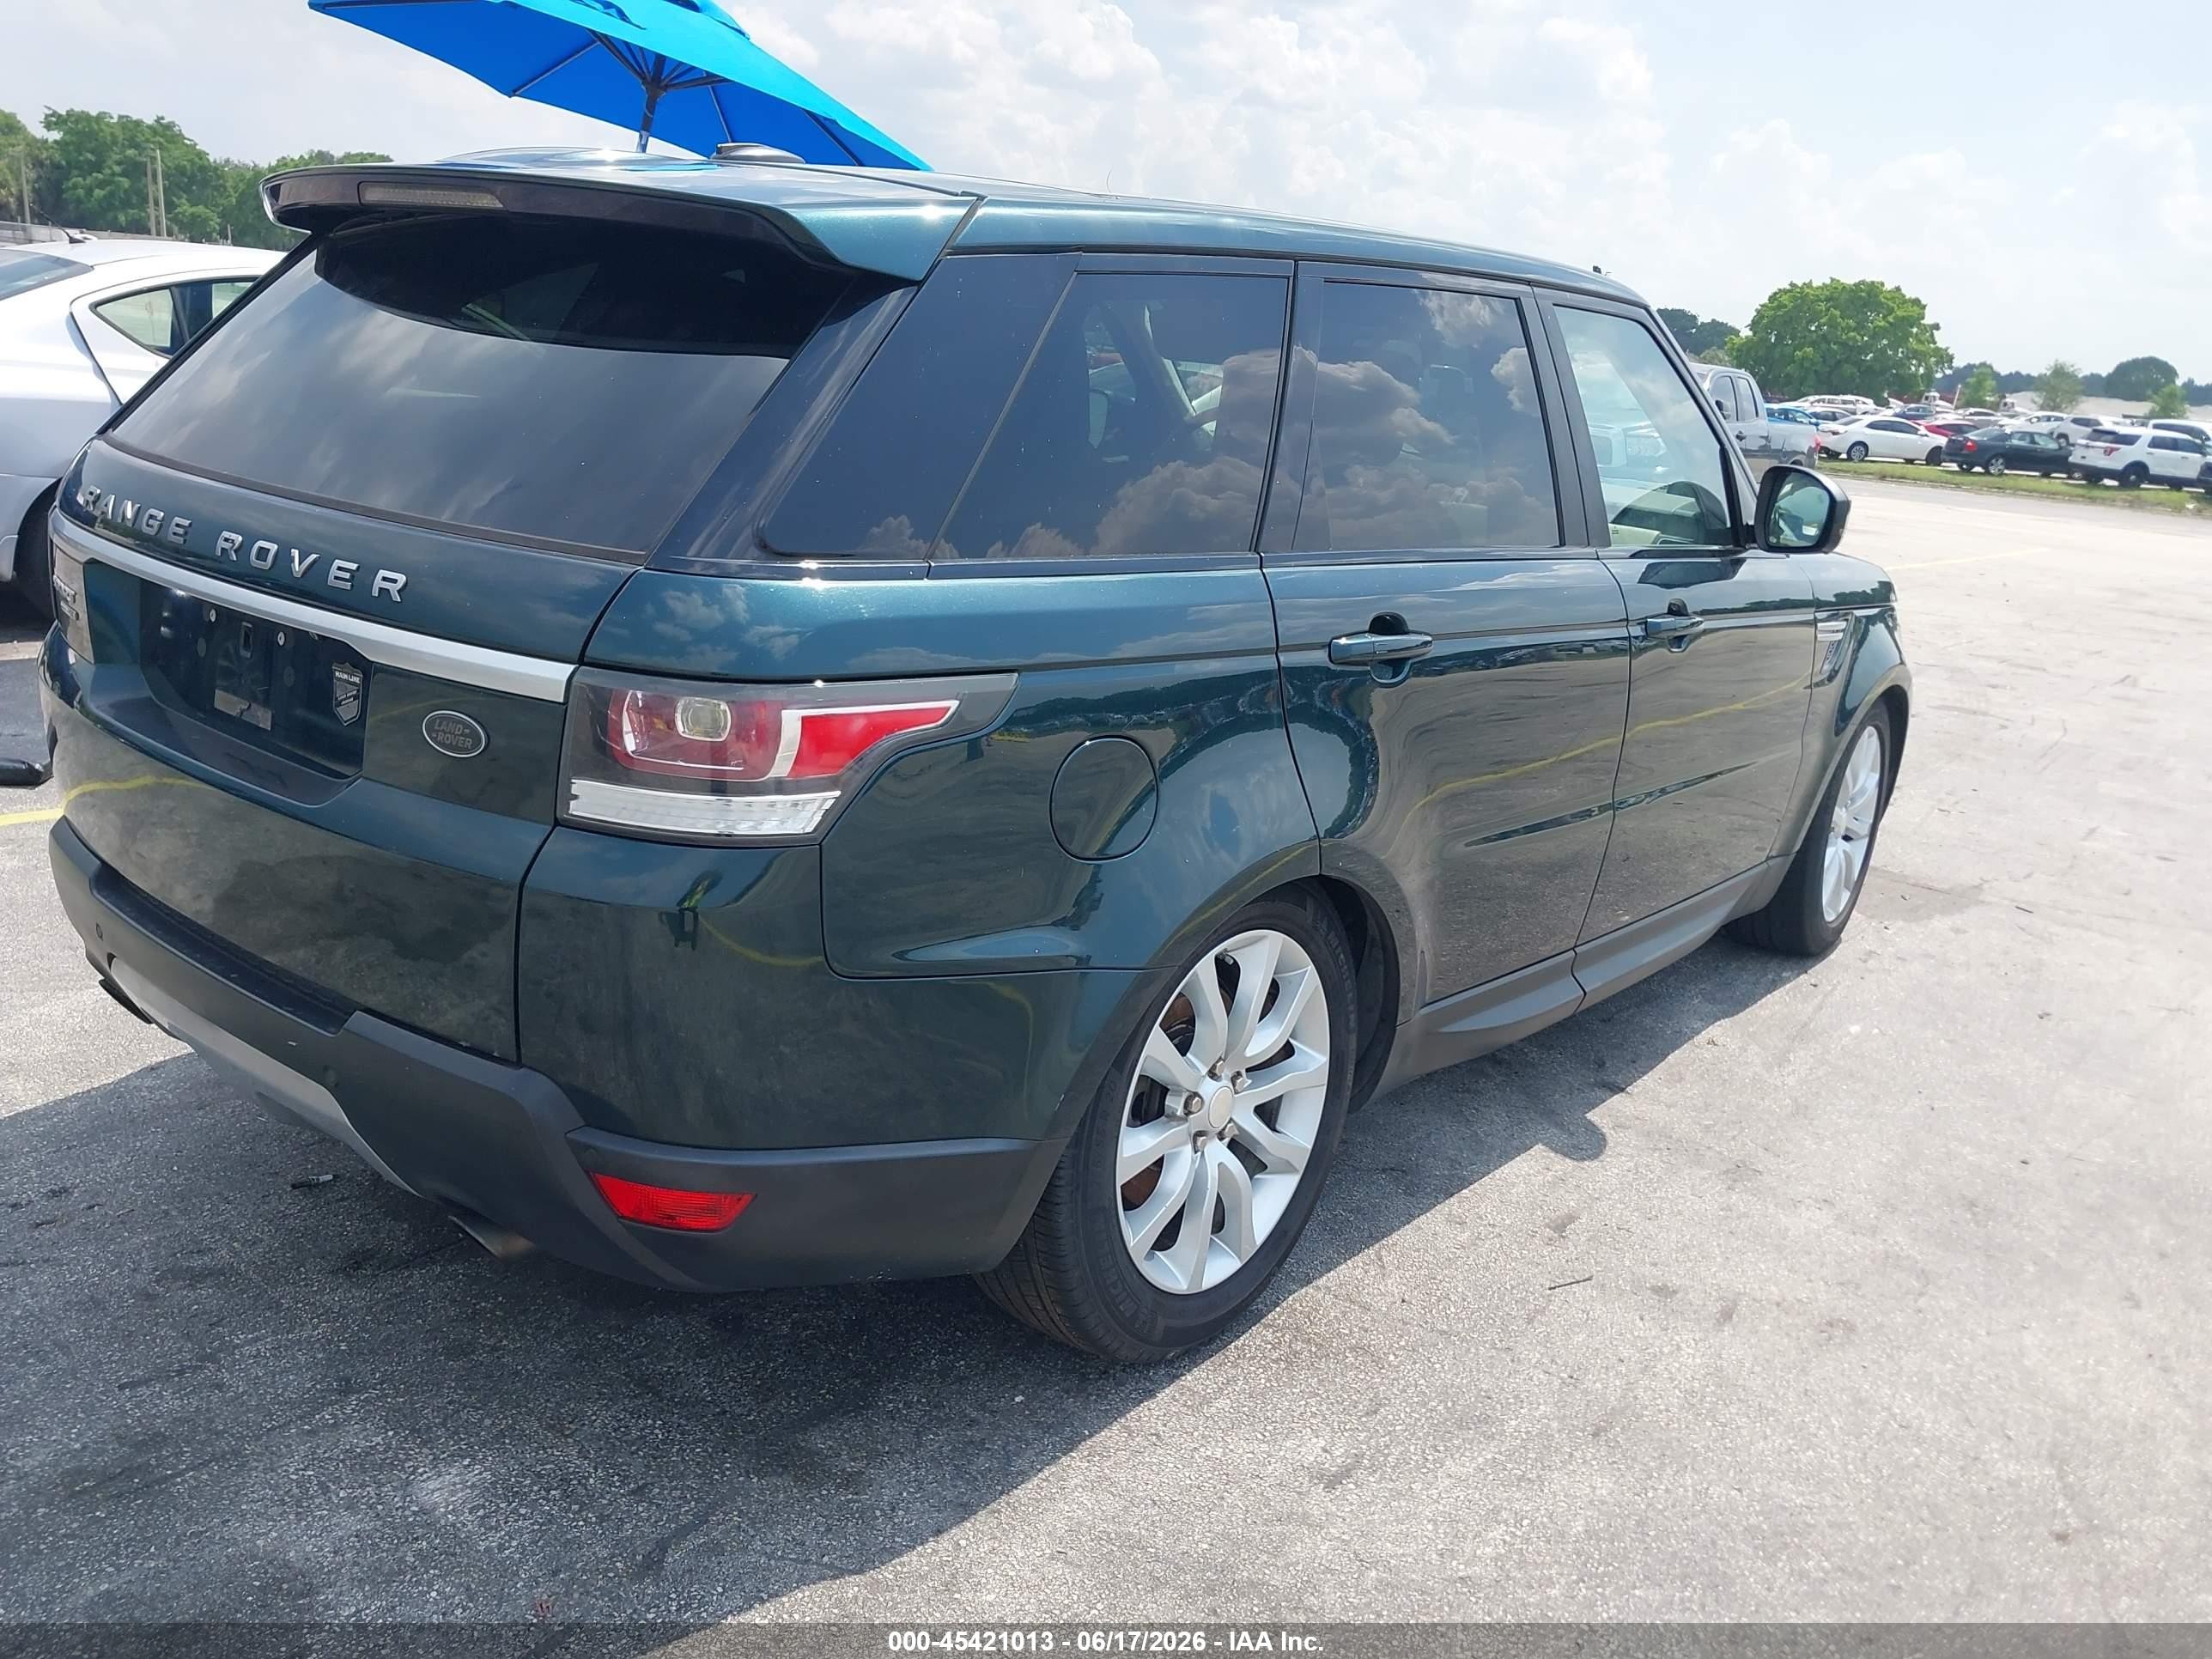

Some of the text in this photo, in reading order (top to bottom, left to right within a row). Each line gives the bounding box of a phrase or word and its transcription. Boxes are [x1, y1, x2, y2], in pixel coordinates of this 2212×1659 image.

[82, 484, 408, 603] RANGE ROVER
[433, 718, 464, 735] LAND
[436, 732, 473, 750] ROVER
